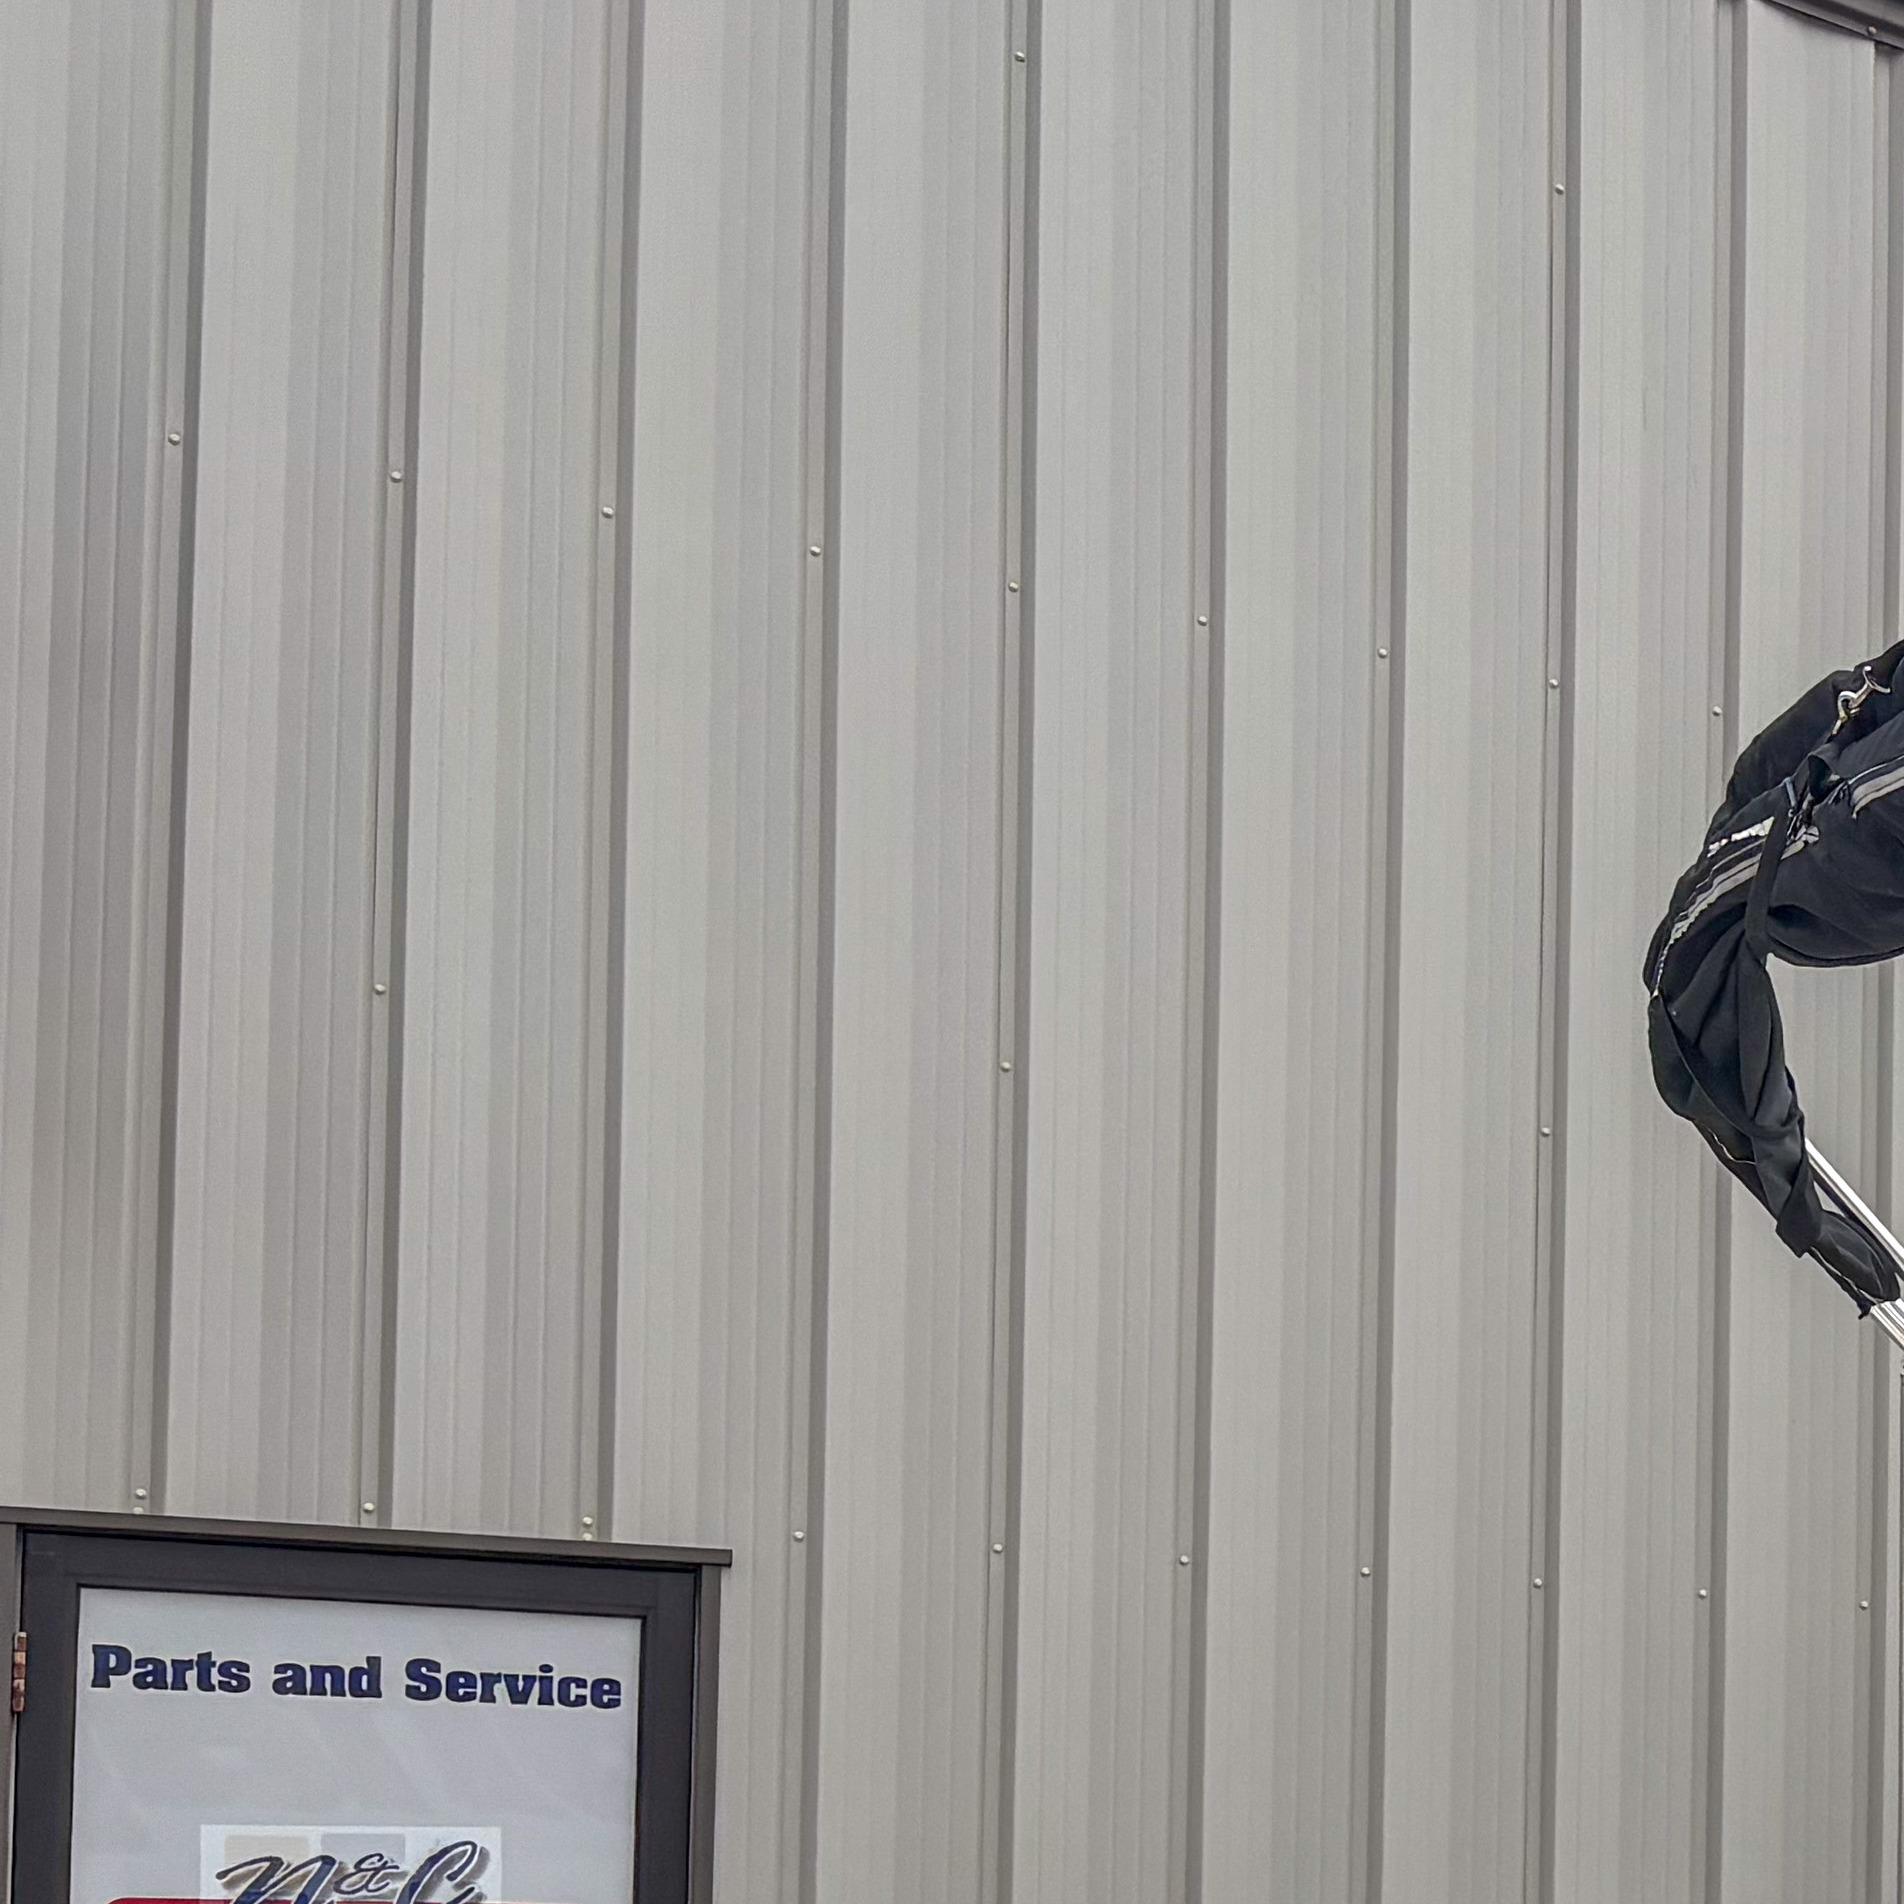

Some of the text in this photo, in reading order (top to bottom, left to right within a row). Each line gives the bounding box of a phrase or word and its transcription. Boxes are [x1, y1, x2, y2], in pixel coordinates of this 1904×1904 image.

[91, 1644, 621, 1709] Parts and Service
